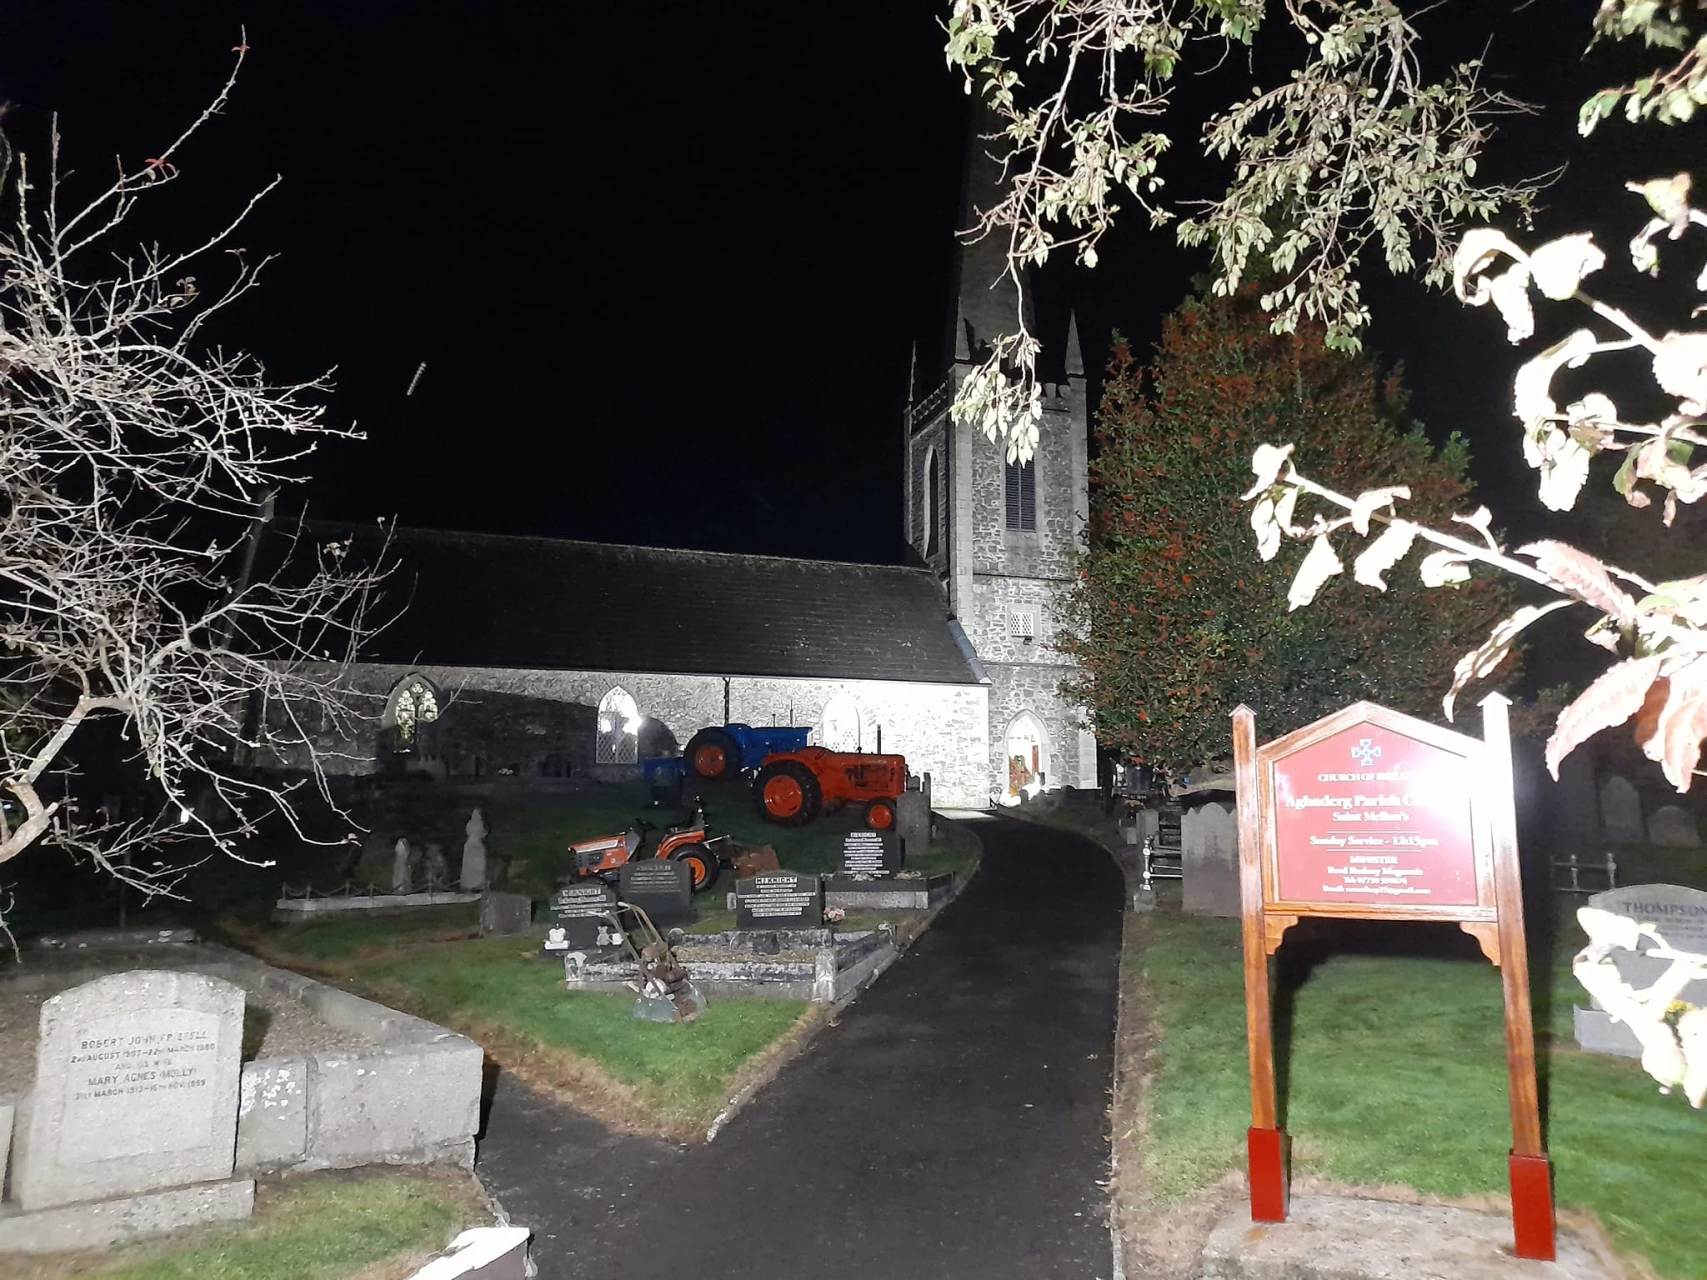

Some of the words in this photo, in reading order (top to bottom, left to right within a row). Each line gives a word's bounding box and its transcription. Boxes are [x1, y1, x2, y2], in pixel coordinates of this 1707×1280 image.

[1317, 772, 1360, 781] CHURCH
[1360, 772, 1375, 781] OF
[1354, 794, 1401, 807] Parish
[1332, 811, 1362, 822] Saint
[1309, 835, 1347, 847] Sunday
[1347, 835, 1384, 845] Service
[1392, 836, 1439, 848] 12:15pm
[1349, 855, 1399, 864] MINISTER
[1622, 901, 1707, 916] THOMPSON
[81, 1037, 124, 1050] ROBERT
[128, 1035, 156, 1046] JOHN
[86, 1051, 120, 1062] AUGUST
[88, 1075, 120, 1086] MARY
[123, 1071, 157, 1083] AGNES
[93, 1087, 124, 1098] MARCH
